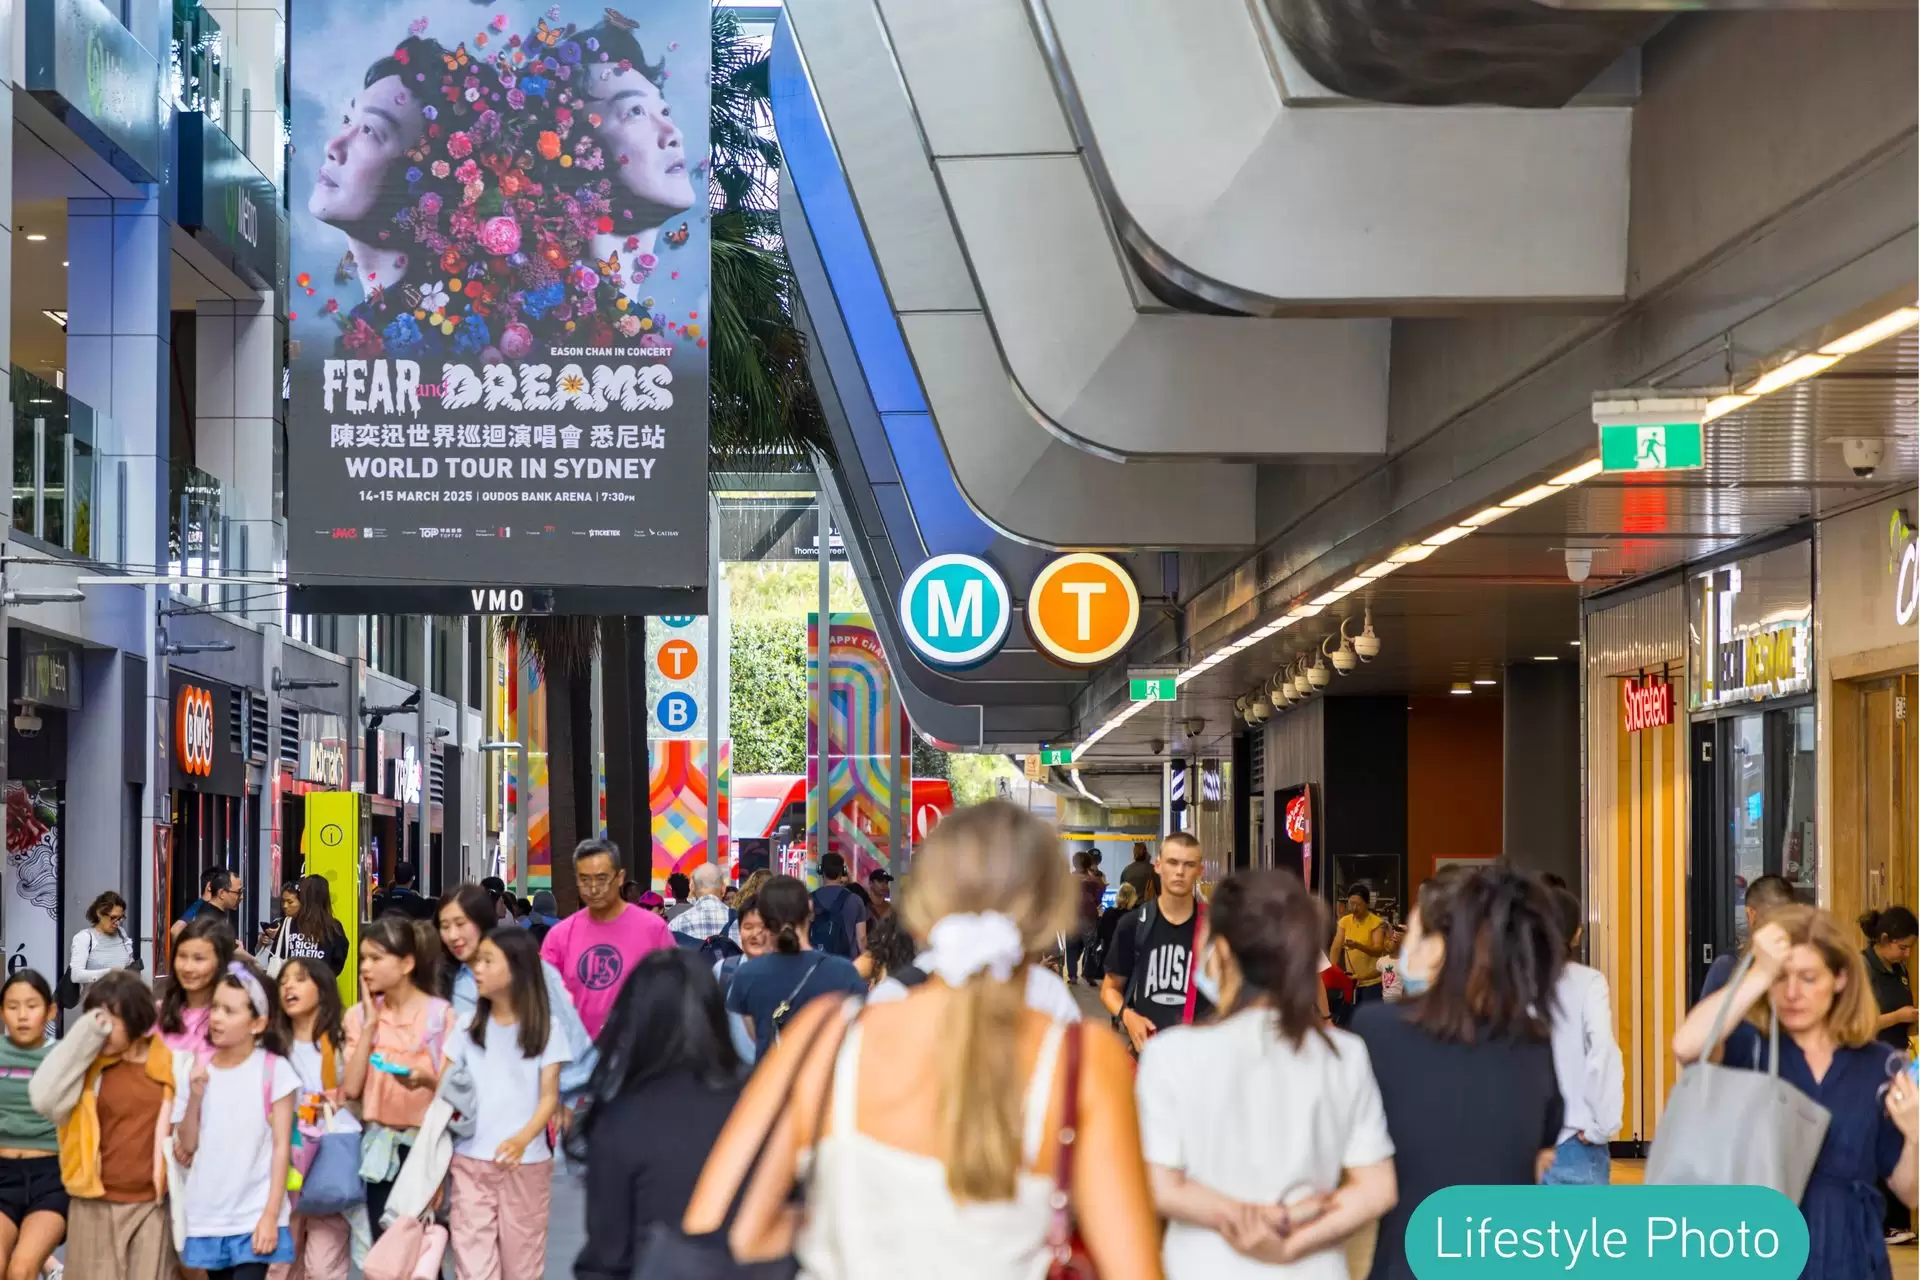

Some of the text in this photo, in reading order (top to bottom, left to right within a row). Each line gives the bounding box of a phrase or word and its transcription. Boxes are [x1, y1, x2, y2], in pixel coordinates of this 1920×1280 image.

[238, 185, 258, 248] Metro
[550, 347, 672, 357] EASON CHAN IN CONCERT
[323, 359, 674, 419] FEAR and DREAMS
[330, 424, 666, 449] 陳奕迅世界巡迴演唱會 悉尼站
[345, 457, 657, 479] WORLD TOUR IN SYDNEY
[359, 490, 394, 502] 14-15
[397, 491, 440, 502] MARCH
[443, 490, 473, 502] 2025
[482, 491, 519, 502] QUDOS
[521, 491, 552, 502] BANK
[554, 491, 593, 502] ARENA
[794, 546, 819, 555] Thoma
[472, 589, 524, 612] VMO
[926, 579, 983, 638] M
[1061, 582, 1107, 641] T
[829, 635, 858, 645] APPY
[668, 648, 688, 675] T
[668, 699, 688, 726] B
[1624, 674, 1668, 732] Sharetea
[295, 941, 319, 950] RICH
